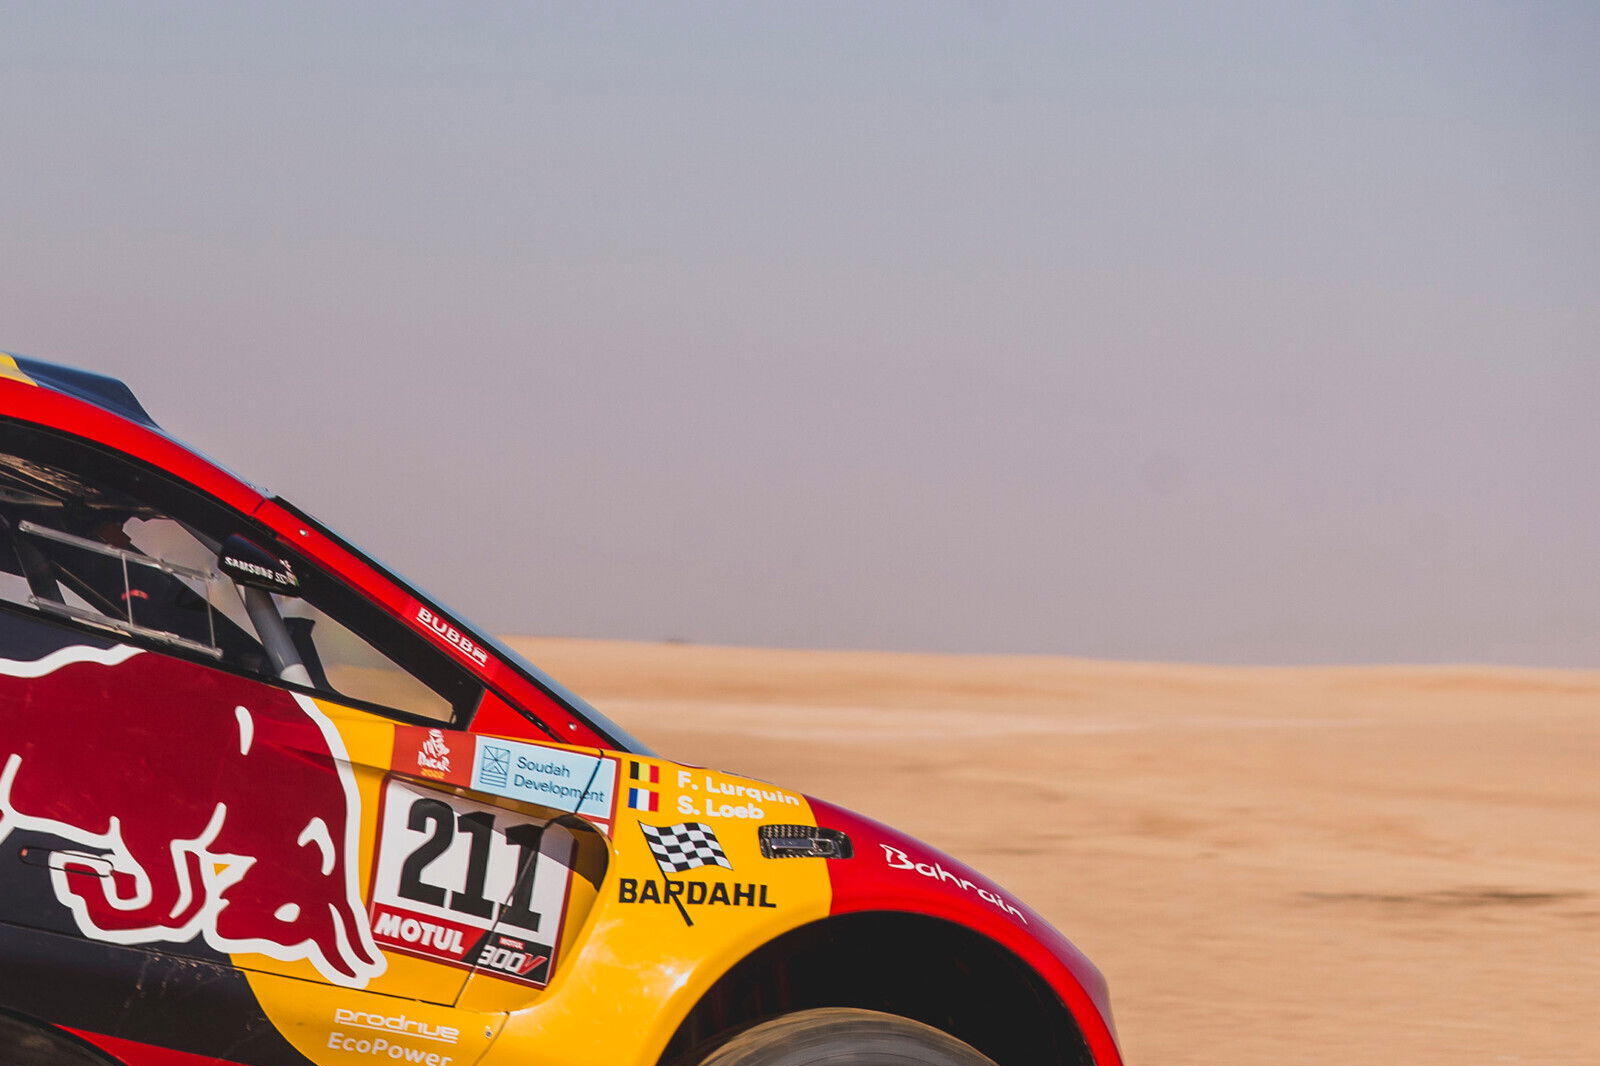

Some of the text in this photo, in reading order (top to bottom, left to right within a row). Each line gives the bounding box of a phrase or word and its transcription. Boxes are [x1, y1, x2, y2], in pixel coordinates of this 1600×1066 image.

[516, 755, 570, 778] Soudah
[513, 774, 605, 804] Development
[677, 769, 800, 807] F. Lurquin
[677, 795, 765, 820] S. Loeb
[397, 797, 543, 932] 211
[618, 877, 777, 909] BARDAHL
[879, 843, 1028, 926] Bahrain
[374, 913, 464, 954] MOTUL
[477, 944, 549, 976] 300V
